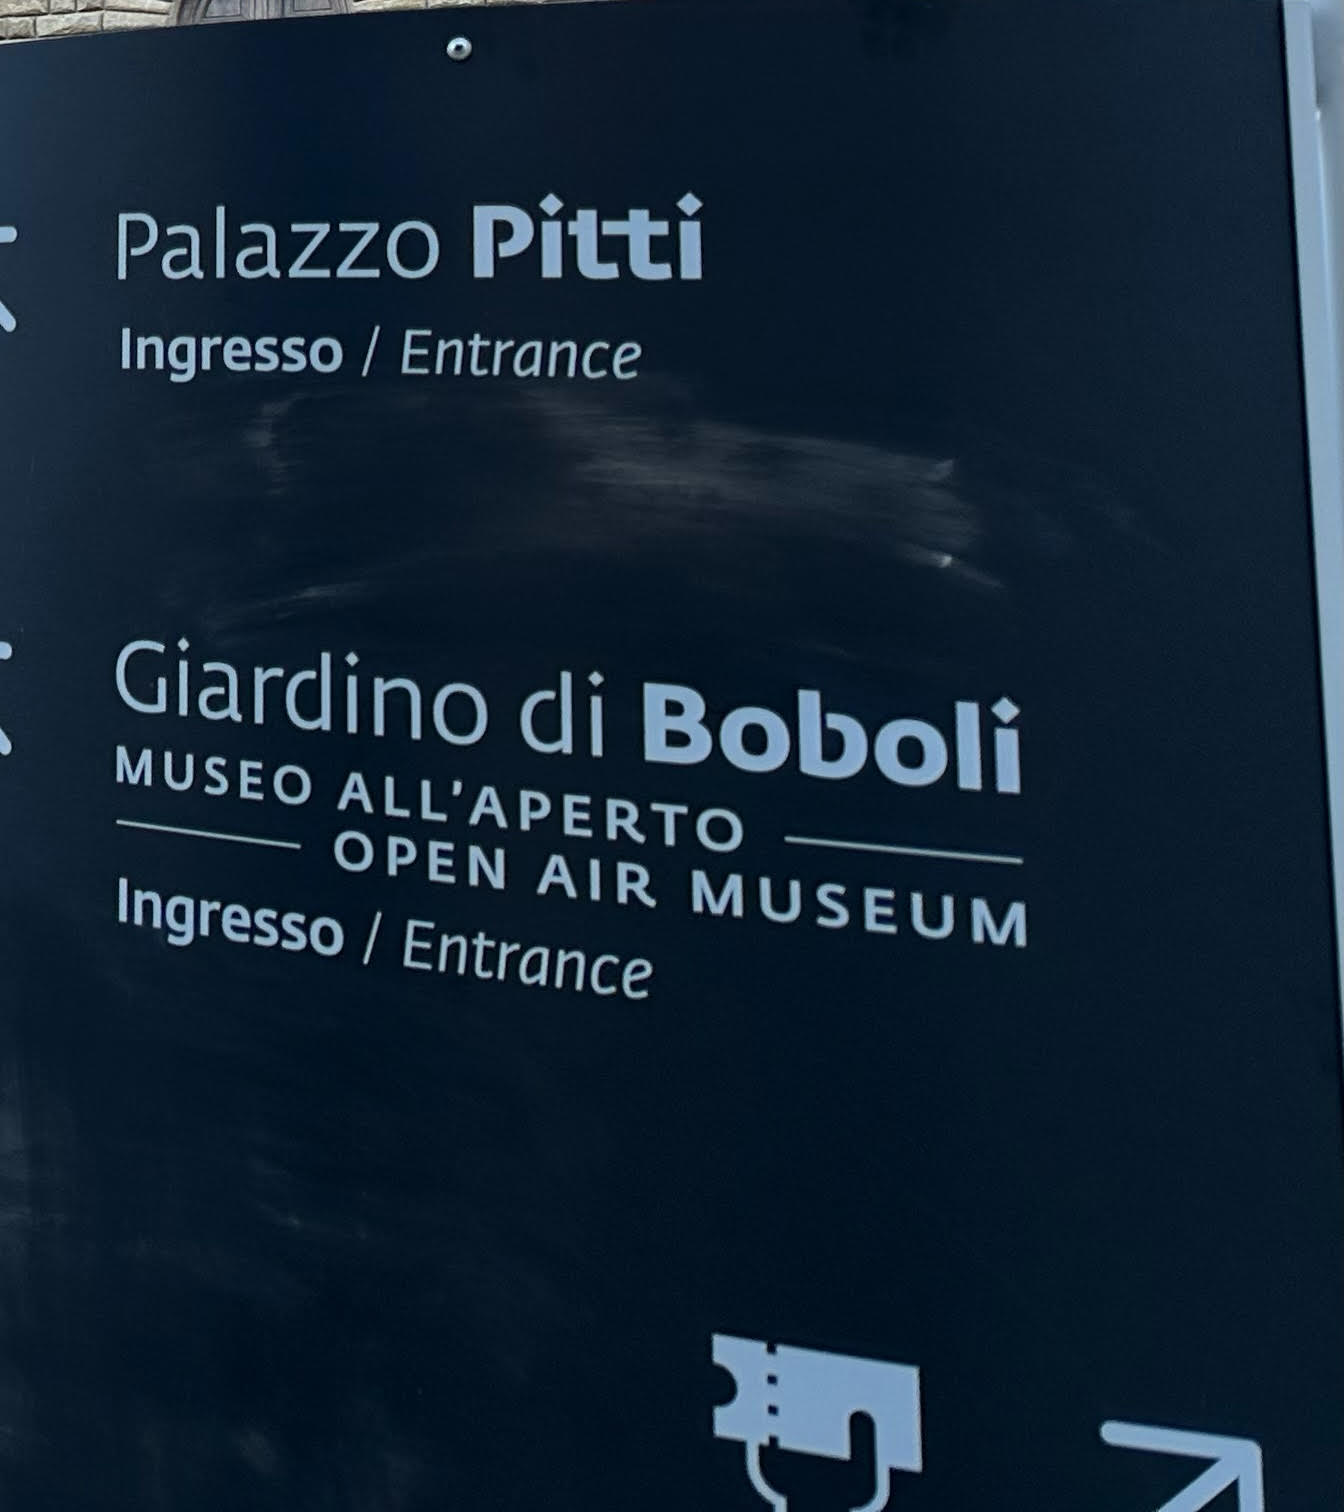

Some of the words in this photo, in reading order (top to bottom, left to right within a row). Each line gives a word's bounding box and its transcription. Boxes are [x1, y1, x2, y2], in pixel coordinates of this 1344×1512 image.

[117, 204, 439, 281] Palazzo
[473, 192, 703, 281] Pitti
[120, 326, 344, 383] Ingresso
[401, 328, 643, 380] Entrance
[115, 636, 489, 746] Giardino
[520, 671, 604, 758] di
[642, 681, 1021, 795] Boboli
[116, 744, 312, 806] MUSEO
[337, 771, 743, 853] ALL'APERTO
[118, 876, 345, 957] Ingresso
[402, 918, 654, 1001] Entrance
[333, 829, 506, 890] OPEN
[537, 853, 658, 909] AIR
[691, 869, 1027, 948] MUSEUM
